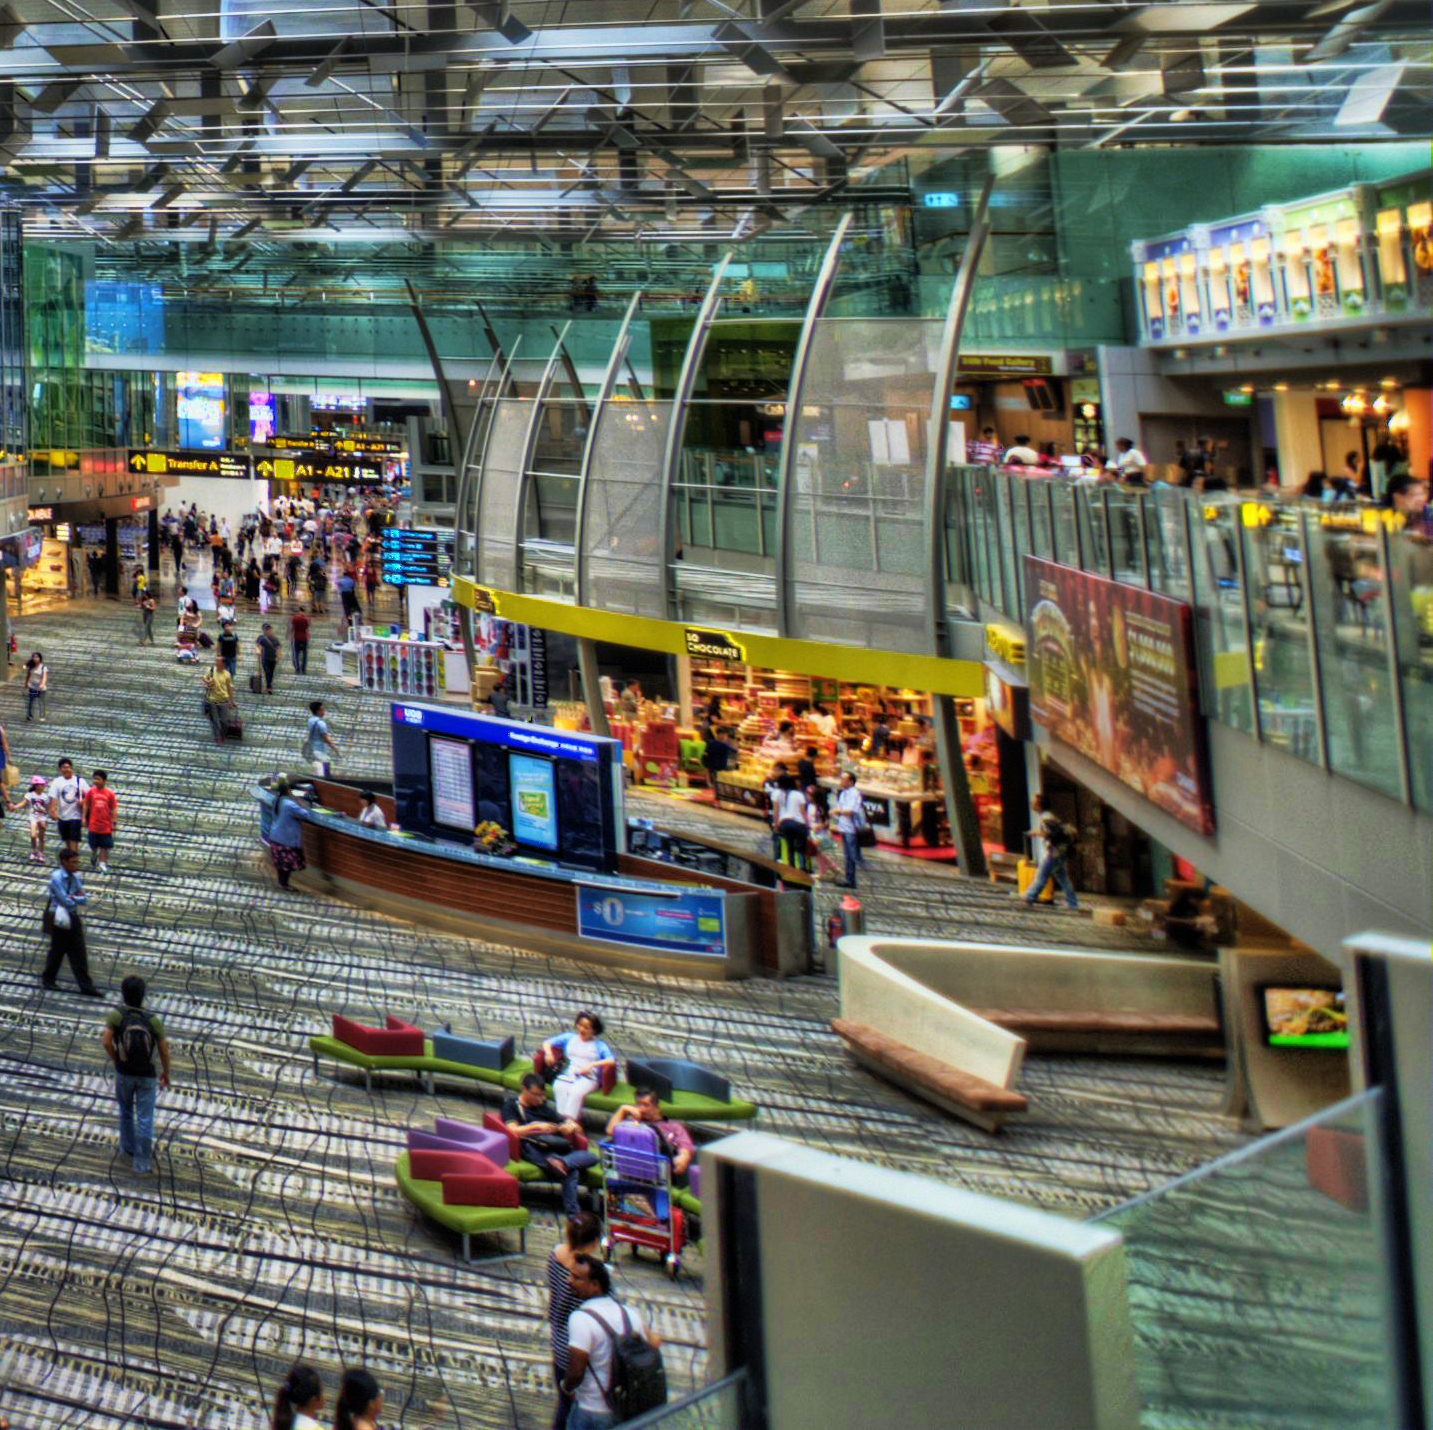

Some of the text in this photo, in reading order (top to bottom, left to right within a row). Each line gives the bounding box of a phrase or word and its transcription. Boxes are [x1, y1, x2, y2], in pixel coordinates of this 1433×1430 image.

[168, 458, 208, 471] Transfer
[209, 460, 219, 471] A
[296, 464, 313, 476] A1
[325, 465, 350, 478] A21
[687, 643, 739, 659] CHOCOLATE
